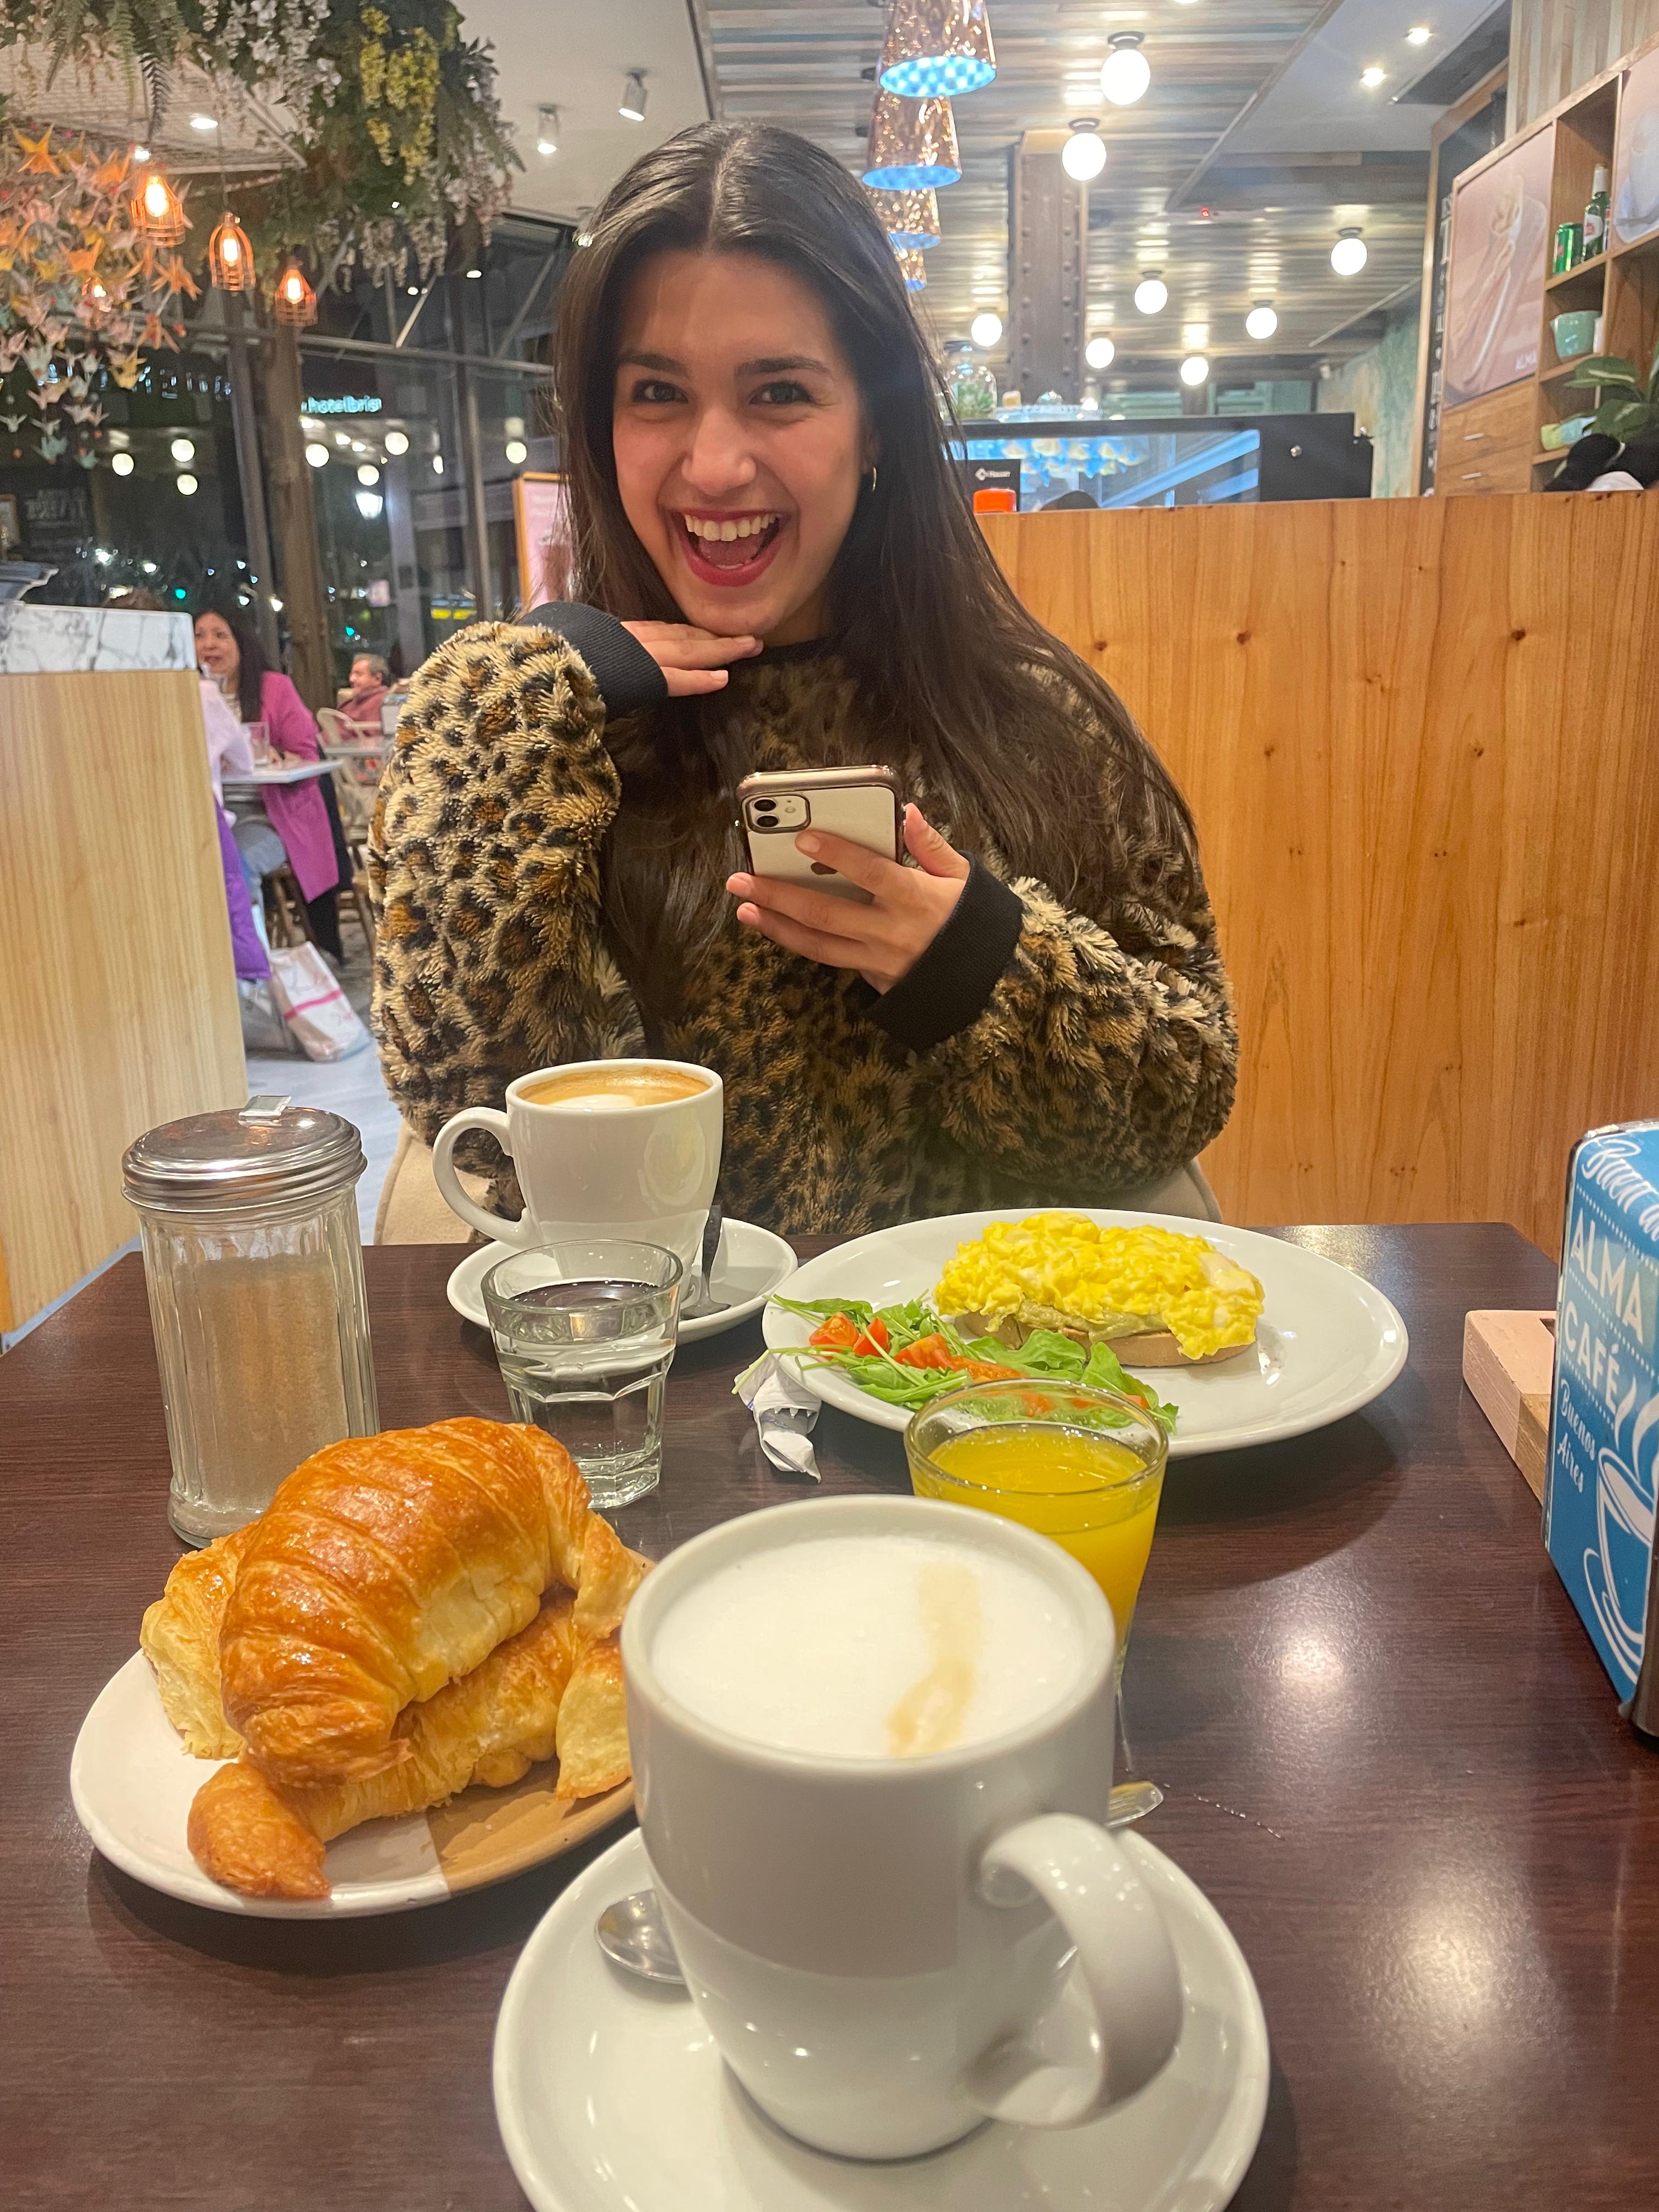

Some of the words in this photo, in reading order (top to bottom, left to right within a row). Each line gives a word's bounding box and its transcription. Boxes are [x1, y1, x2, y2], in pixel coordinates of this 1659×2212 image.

[1571, 1208, 1643, 1344] ALMA
[1565, 1301, 1619, 1414] CAFÉ
[1557, 1432, 1584, 1493] Aires
[1560, 1379, 1595, 1461] Buenos
